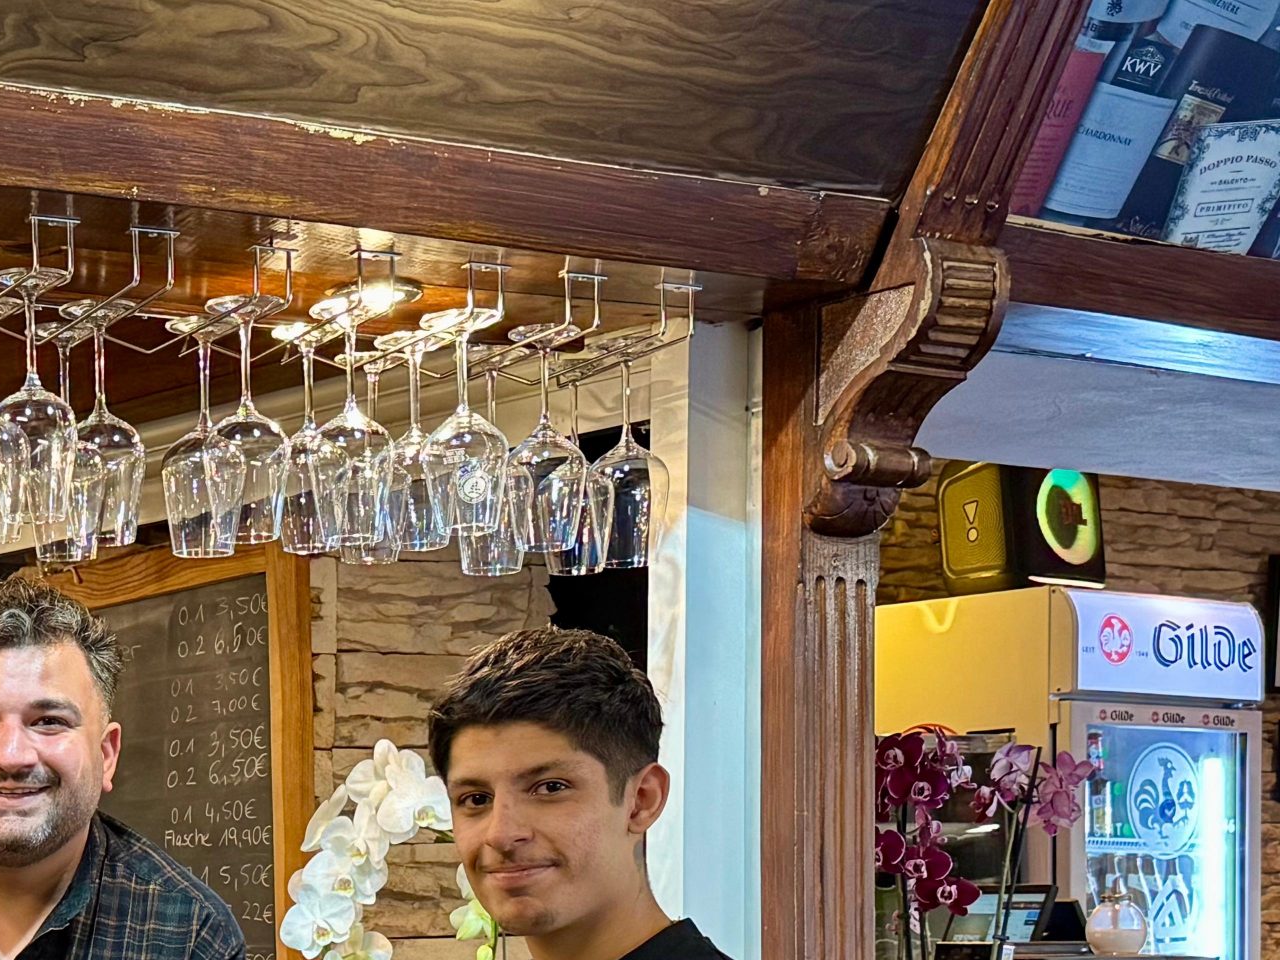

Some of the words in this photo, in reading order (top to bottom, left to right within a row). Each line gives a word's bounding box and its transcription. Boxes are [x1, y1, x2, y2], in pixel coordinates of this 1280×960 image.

[1122, 57, 1162, 77] KWV
[1078, 124, 1132, 146] CHARDONNAY
[1200, 155, 1243, 175] DOPPIO
[1246, 155, 1277, 169] PASSO
[1152, 619, 1257, 672] Gilde
[1110, 710, 1134, 722] Gilde
[1162, 711, 1185, 724] Gilde
[1212, 714, 1235, 727] Gilde
[170, 738, 194, 757] 0.1
[205, 799, 257, 823] 4,50€
[165, 829, 212, 848] Flasche
[219, 825, 272, 848] 19,90€
[219, 864, 273, 892] 5,50€
[241, 901, 274, 924] 22€
